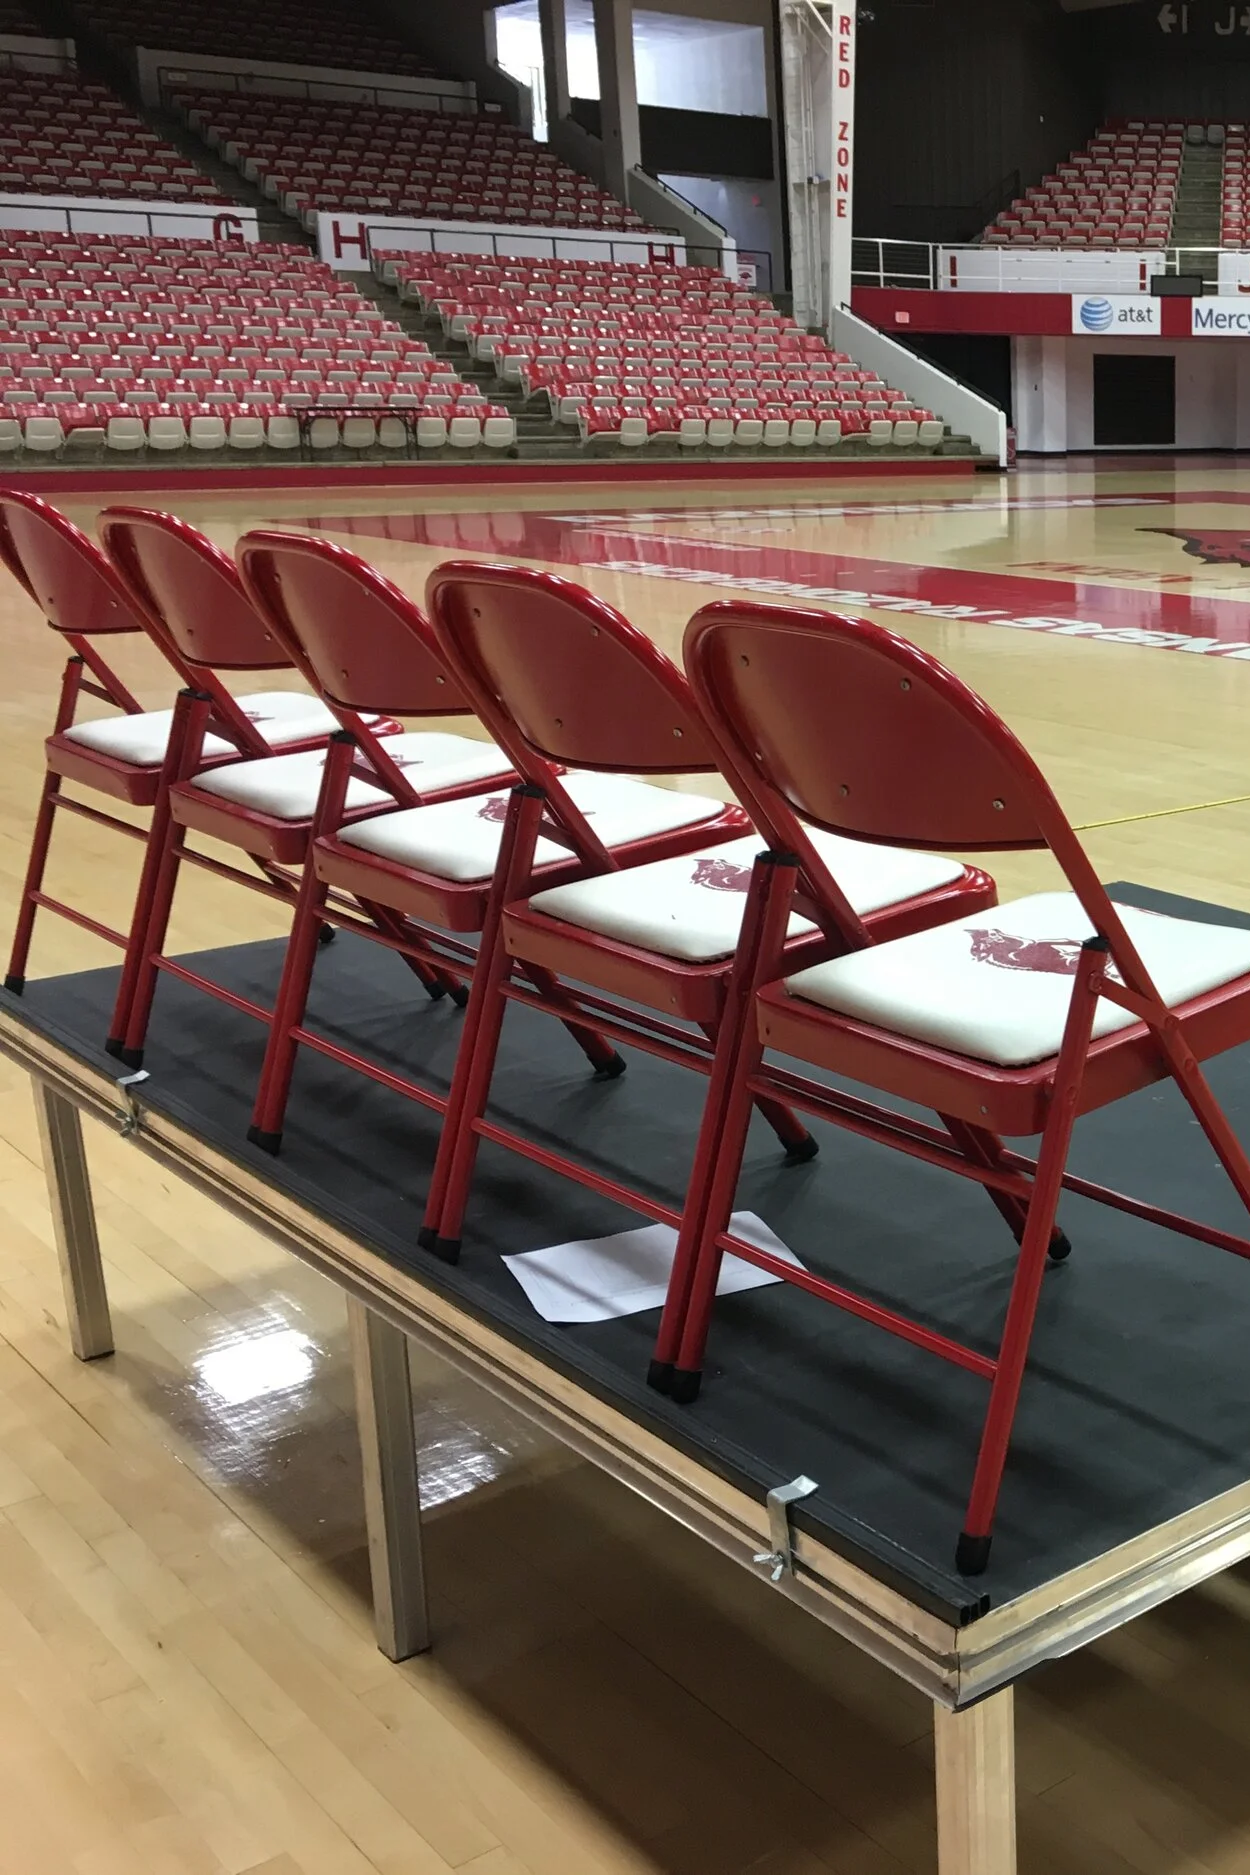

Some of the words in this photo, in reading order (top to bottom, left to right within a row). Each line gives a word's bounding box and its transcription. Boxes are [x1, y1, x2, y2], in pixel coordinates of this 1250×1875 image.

[1214, 6, 1236, 35] J
[838, 15, 852, 88] RED
[836, 121, 850, 219] ZONE
[213, 213, 244, 243] G
[332, 220, 368, 260] H
[647, 241, 675, 267] H
[1117, 306, 1154, 323] at&t
